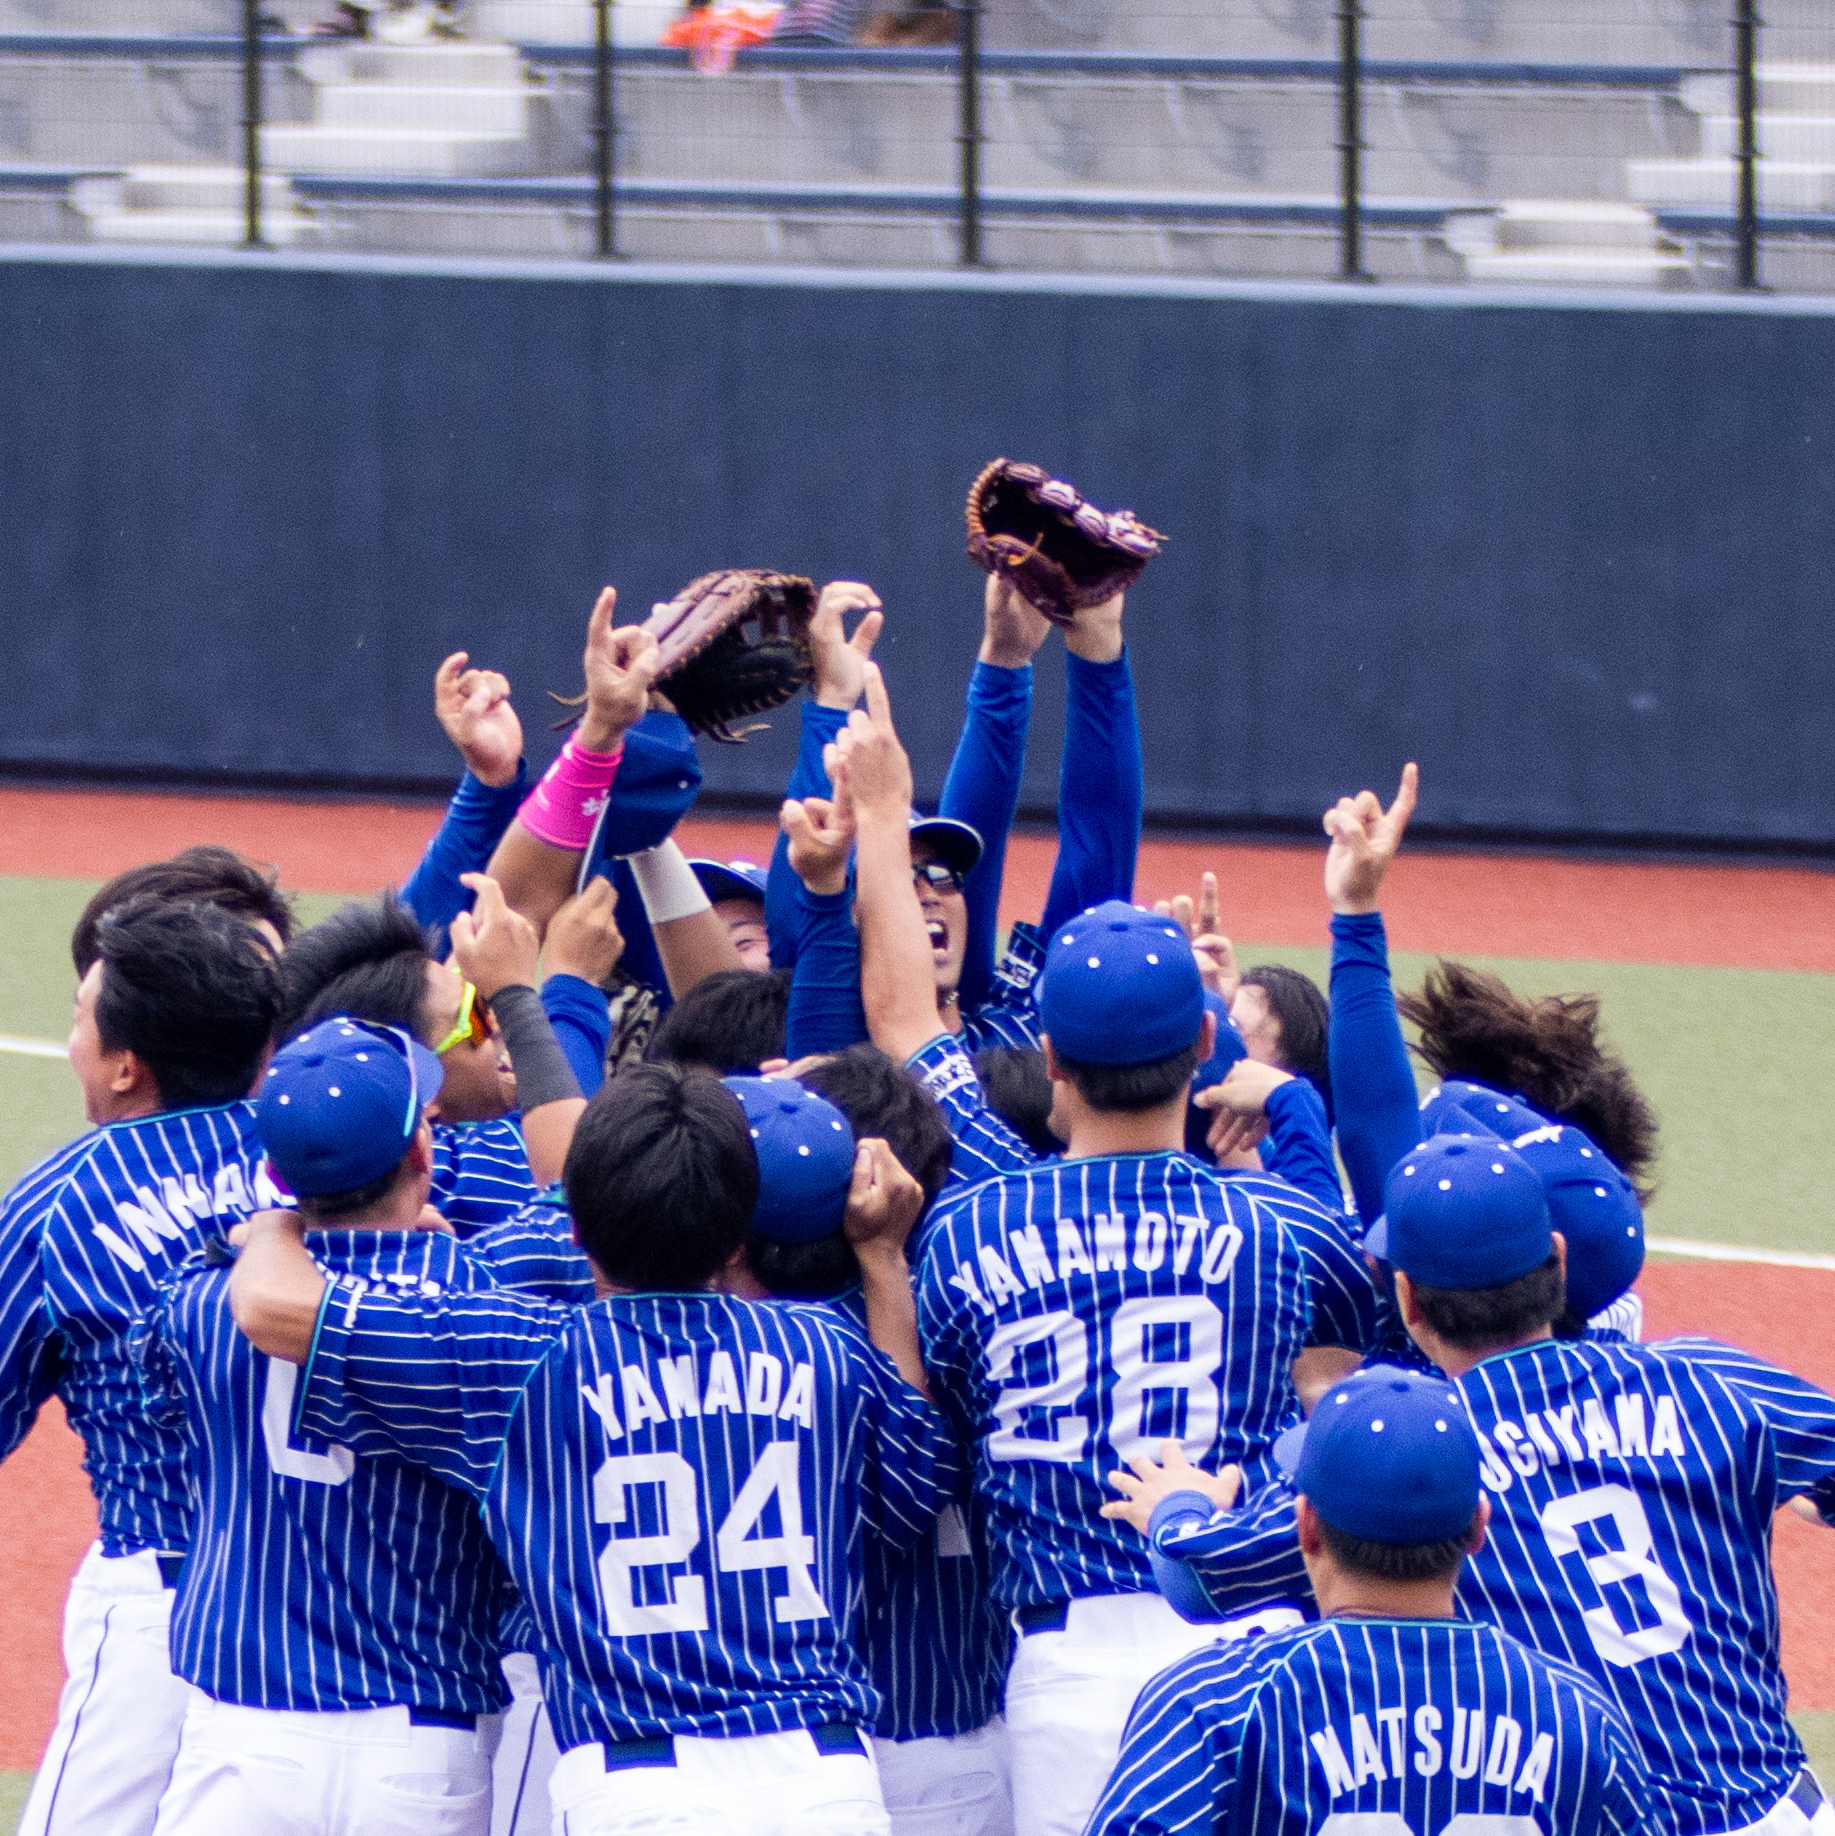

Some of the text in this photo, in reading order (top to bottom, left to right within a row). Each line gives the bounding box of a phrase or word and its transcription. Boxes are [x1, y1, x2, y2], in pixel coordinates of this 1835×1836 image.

[949, 1211, 1244, 1317] YAMAMOTO
[581, 1351, 815, 1441] YAMADA
[984, 1295, 1224, 1466] 28
[592, 1441, 830, 1636] 24
[1540, 1482, 1693, 1668] 3
[1310, 1704, 1555, 1801] MATSUDA
